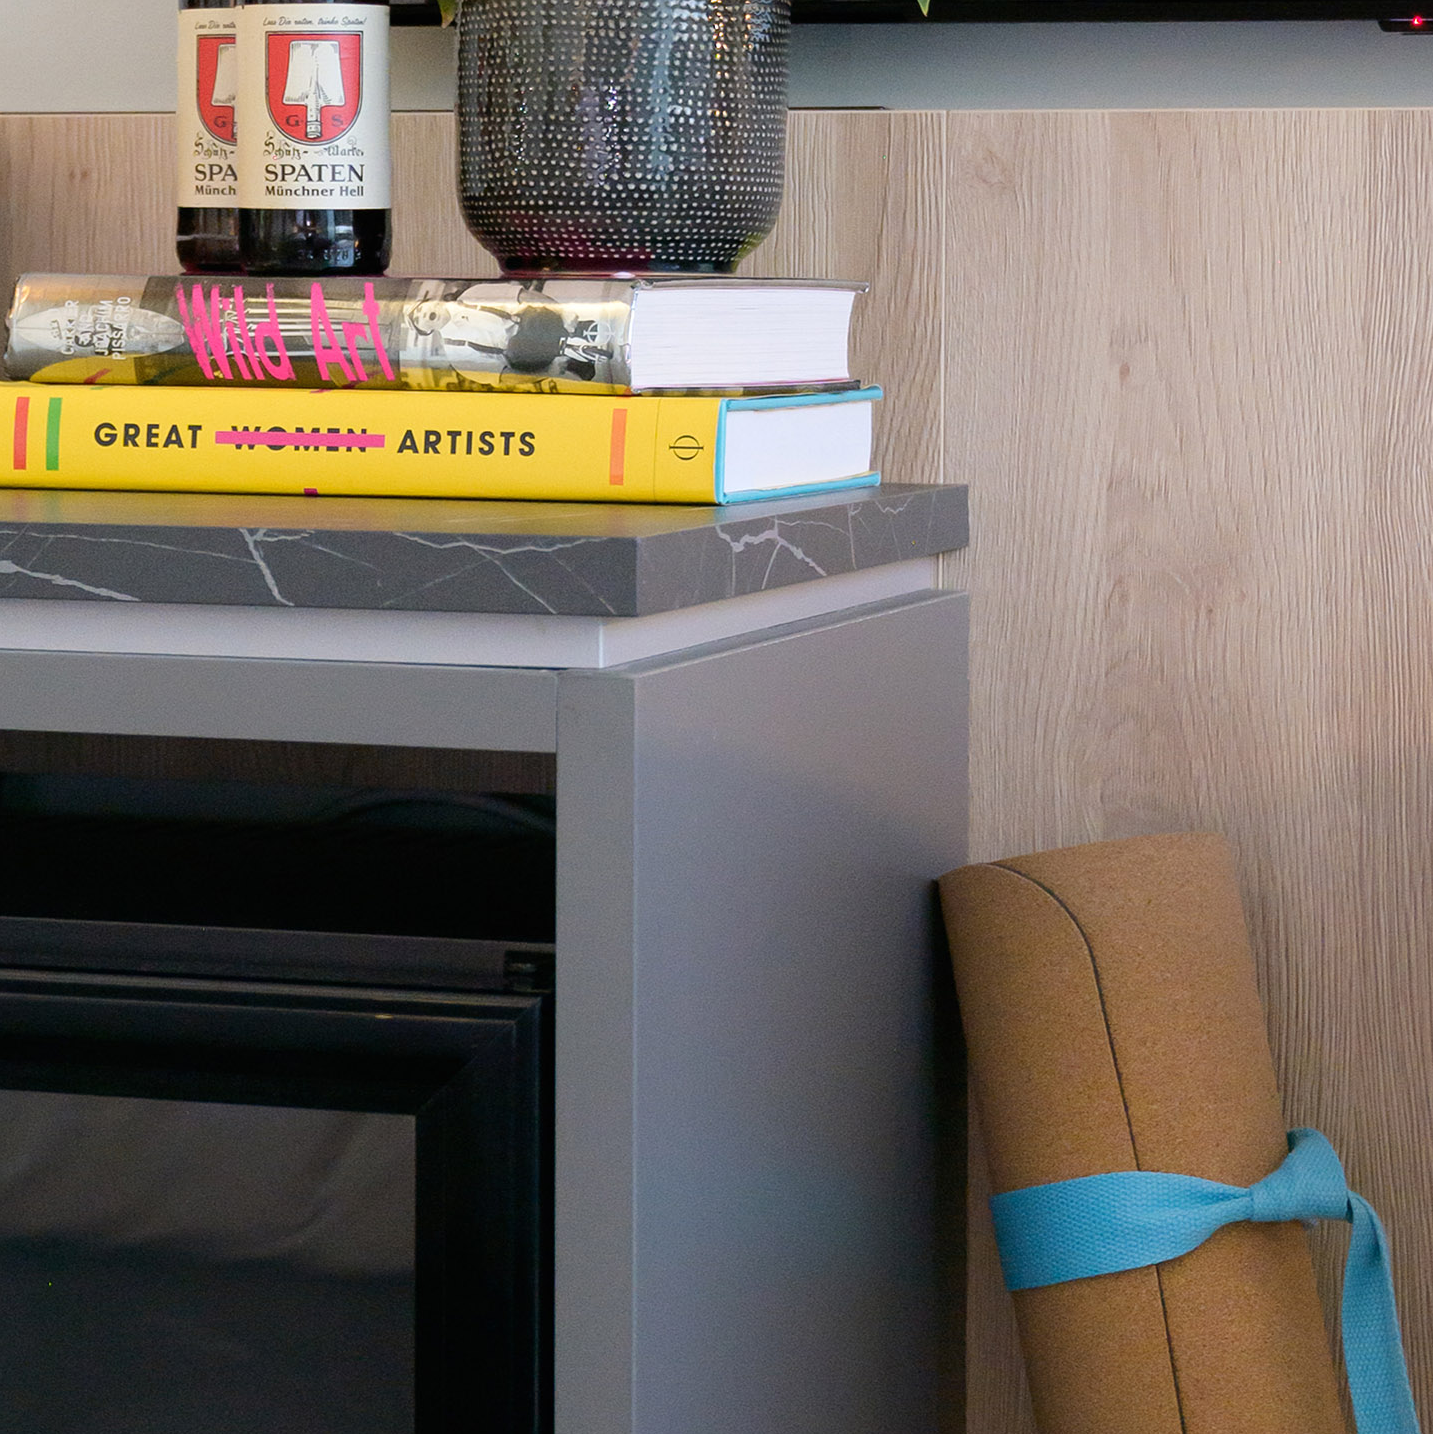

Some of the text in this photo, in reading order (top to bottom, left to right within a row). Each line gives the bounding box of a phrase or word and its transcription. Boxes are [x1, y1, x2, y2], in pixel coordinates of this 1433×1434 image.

[193, 163, 238, 183] SPA
[263, 163, 365, 183] SPATEN
[194, 184, 237, 196] Münch
[264, 185, 364, 197] Münchner Hell
[94, 299, 113, 356] JOACHIM
[111, 296, 131, 360] PISSARRO
[175, 281, 396, 382] Wild Art
[93, 421, 536, 458] GREAT WOMEN ARTISTS
